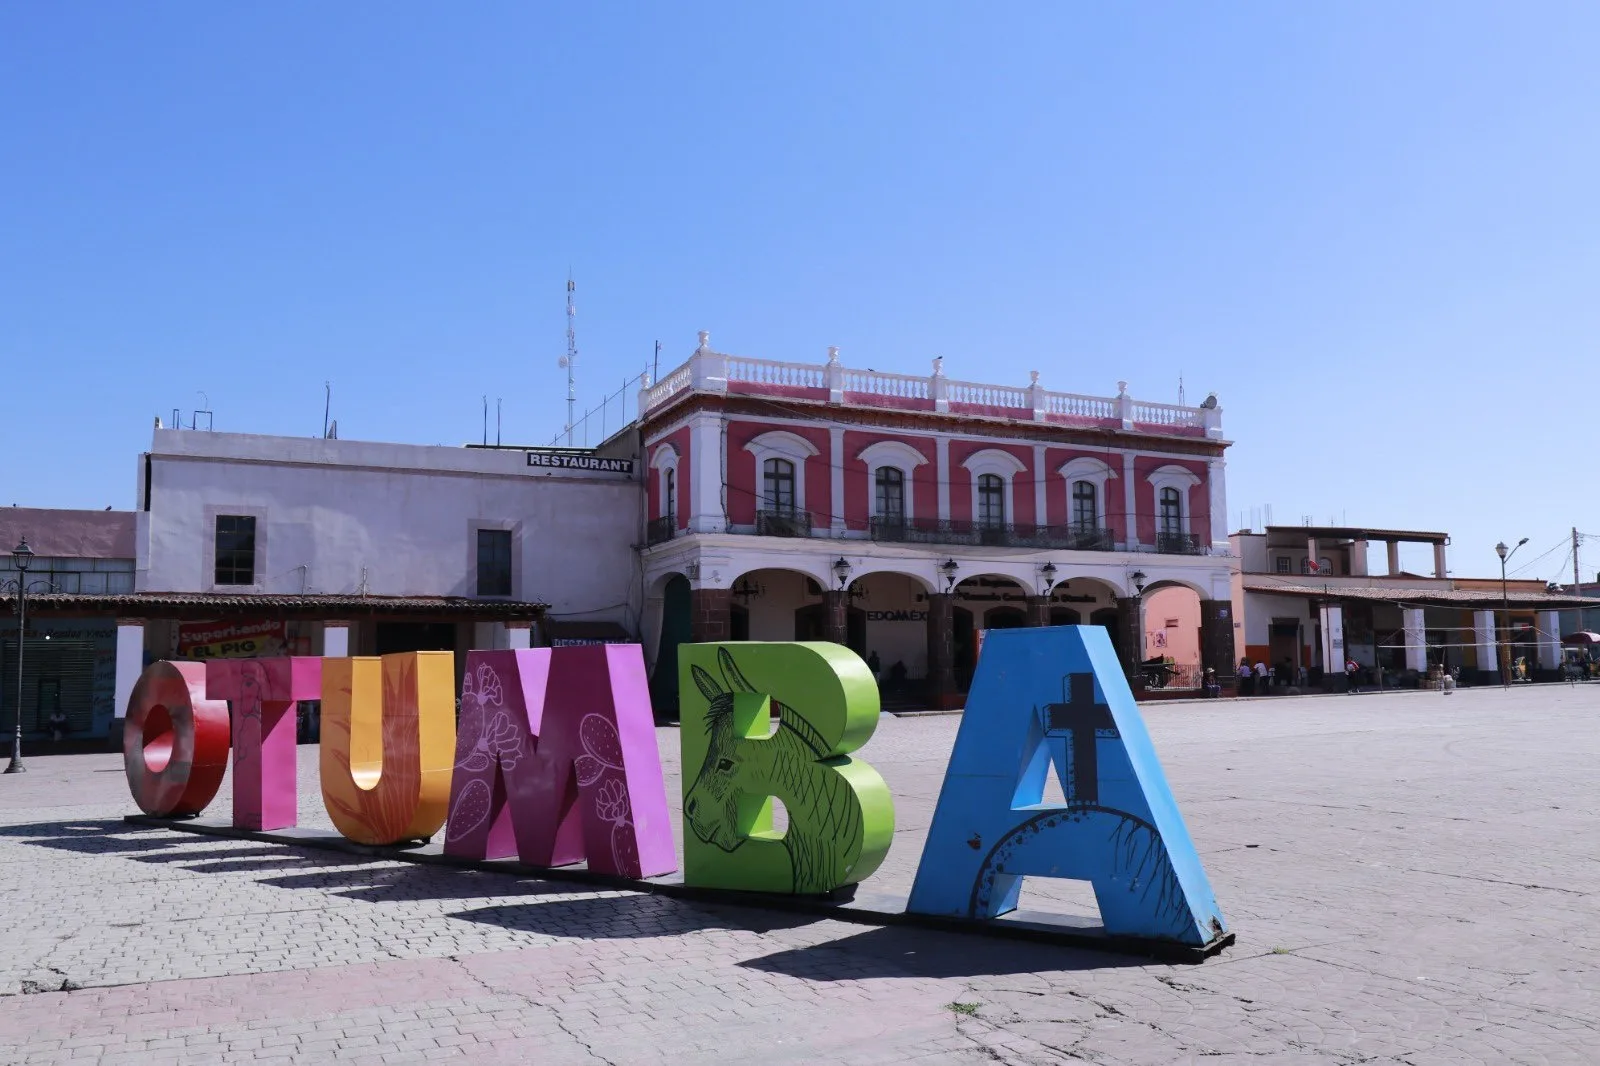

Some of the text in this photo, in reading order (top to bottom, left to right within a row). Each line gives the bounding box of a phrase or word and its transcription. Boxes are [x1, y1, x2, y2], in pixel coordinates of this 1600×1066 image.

[530, 454, 630, 471] RESTAURANT
[194, 641, 256, 657] EL PIG
[123, 625, 1231, 951] OTUMBA
